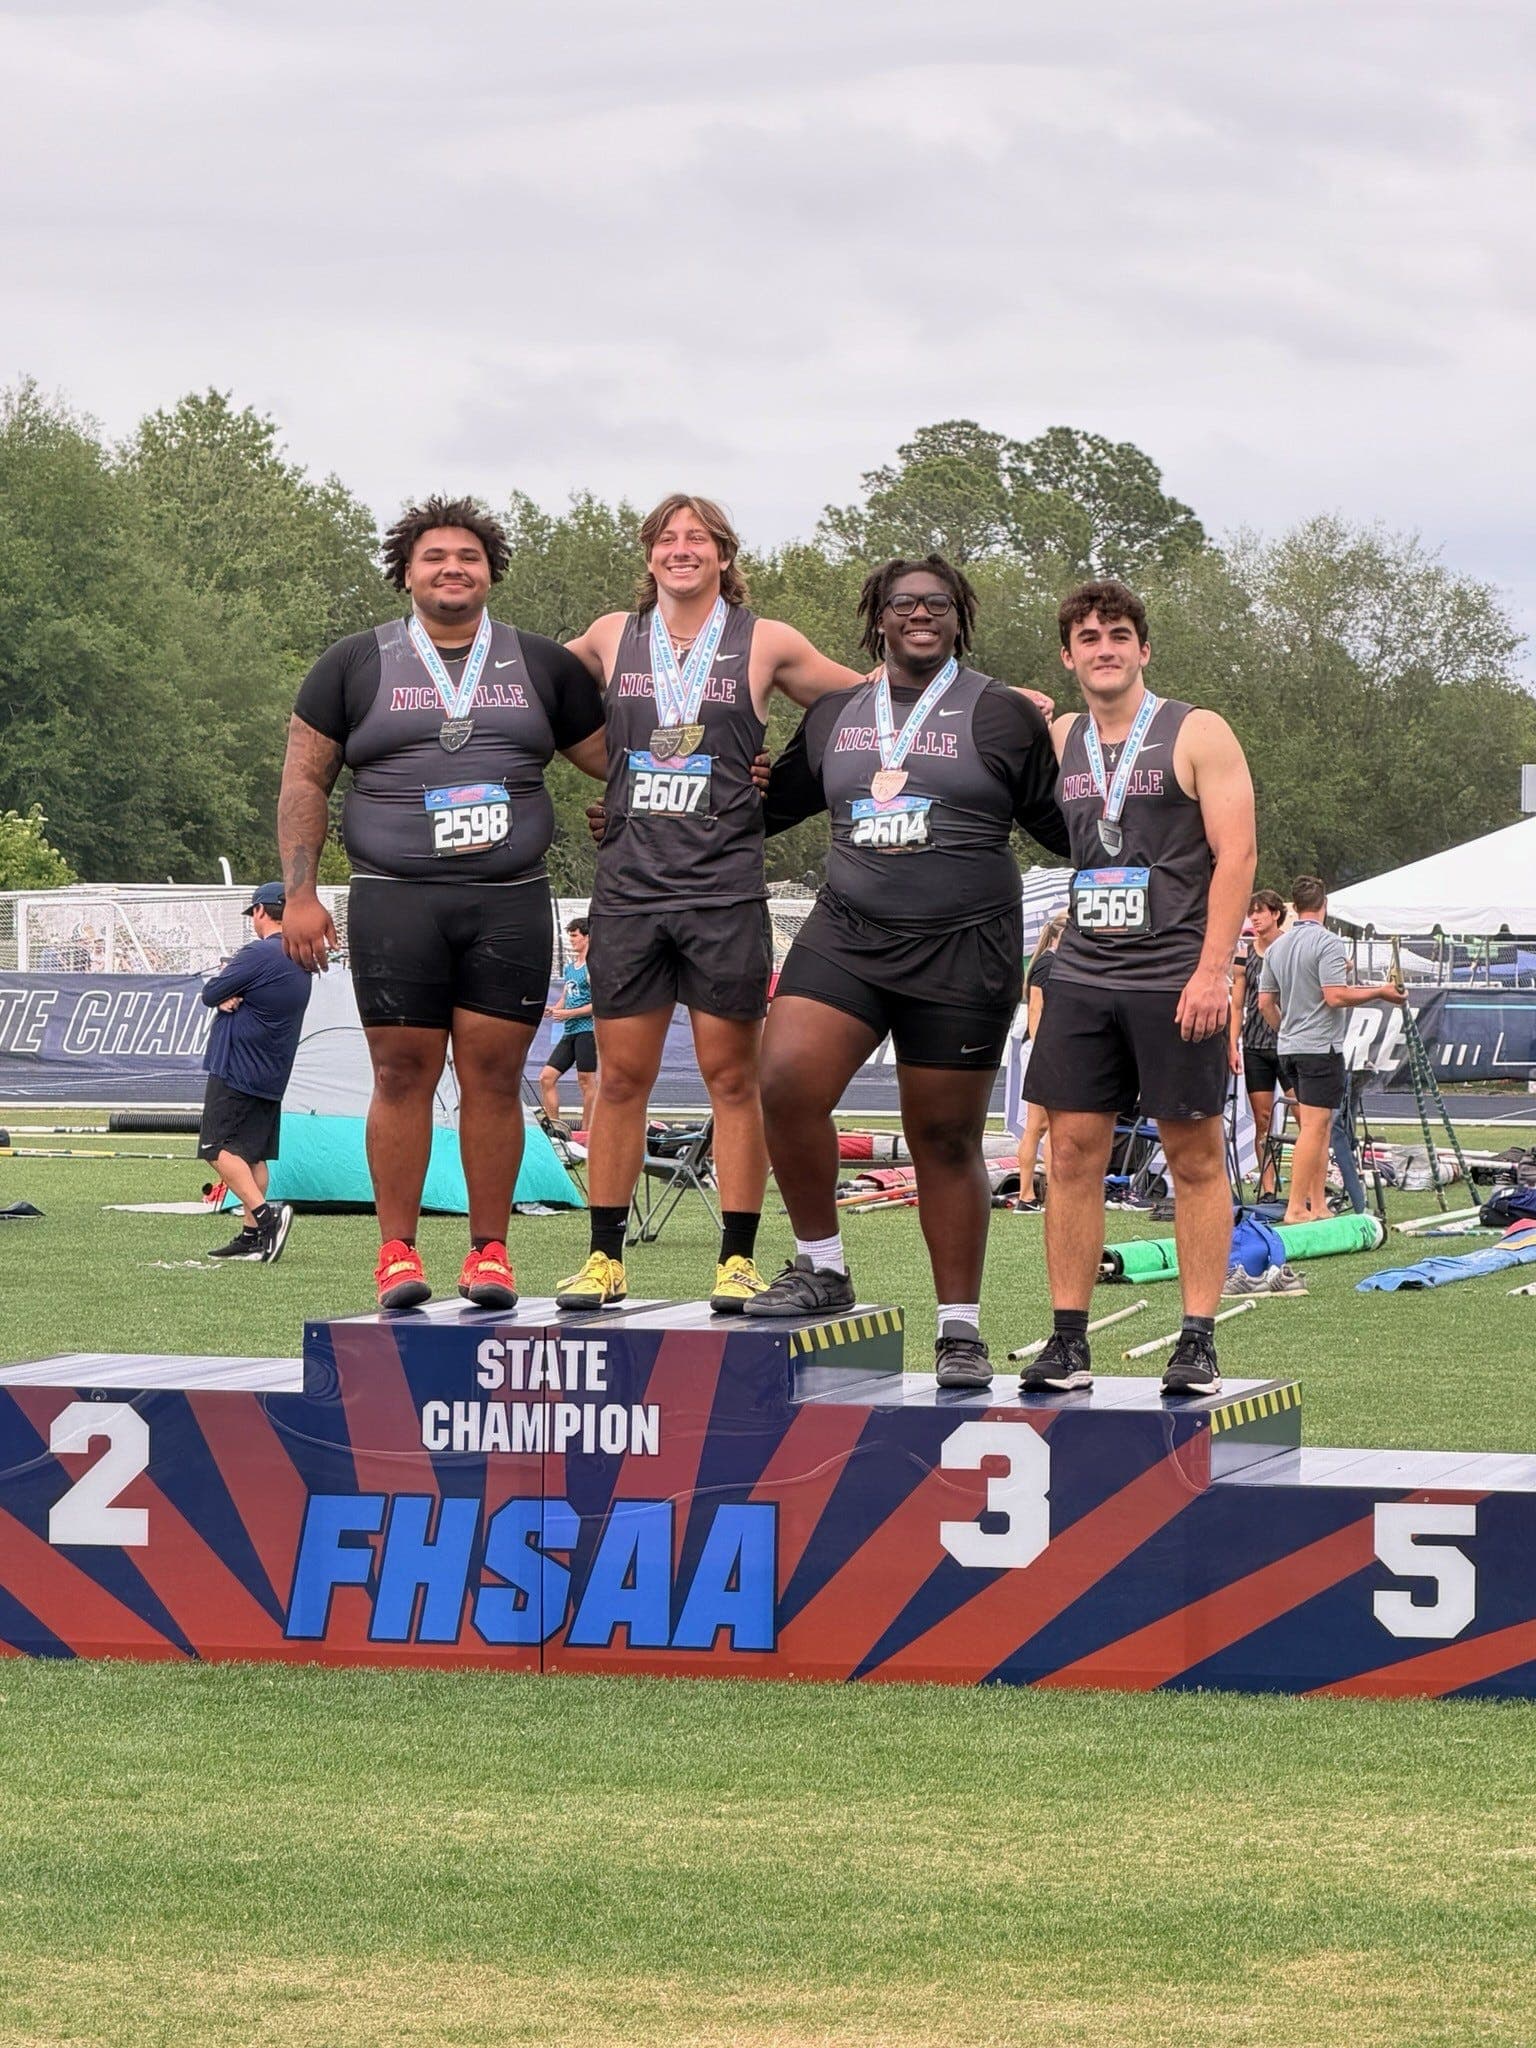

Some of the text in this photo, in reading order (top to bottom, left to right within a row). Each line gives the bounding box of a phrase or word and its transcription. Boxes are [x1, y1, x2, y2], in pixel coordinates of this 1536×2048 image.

[475, 643, 485, 664] FIELD
[696, 660, 708, 687] TRACK
[707, 627, 718, 650] FIELD
[631, 771, 708, 813] 2607
[434, 804, 509, 848] 2598
[854, 811, 928, 848] 2604
[1076, 888, 1146, 928] 2569
[730, 1272, 761, 1287] NIKE
[476, 1338, 608, 1391] STATE
[421, 1402, 660, 1456] CHAMPION
[49, 1402, 149, 1546] 2
[940, 1421, 1051, 1568] 3
[283, 1492, 781, 1652] FHSAA
[1373, 1503, 1477, 1640] 5
